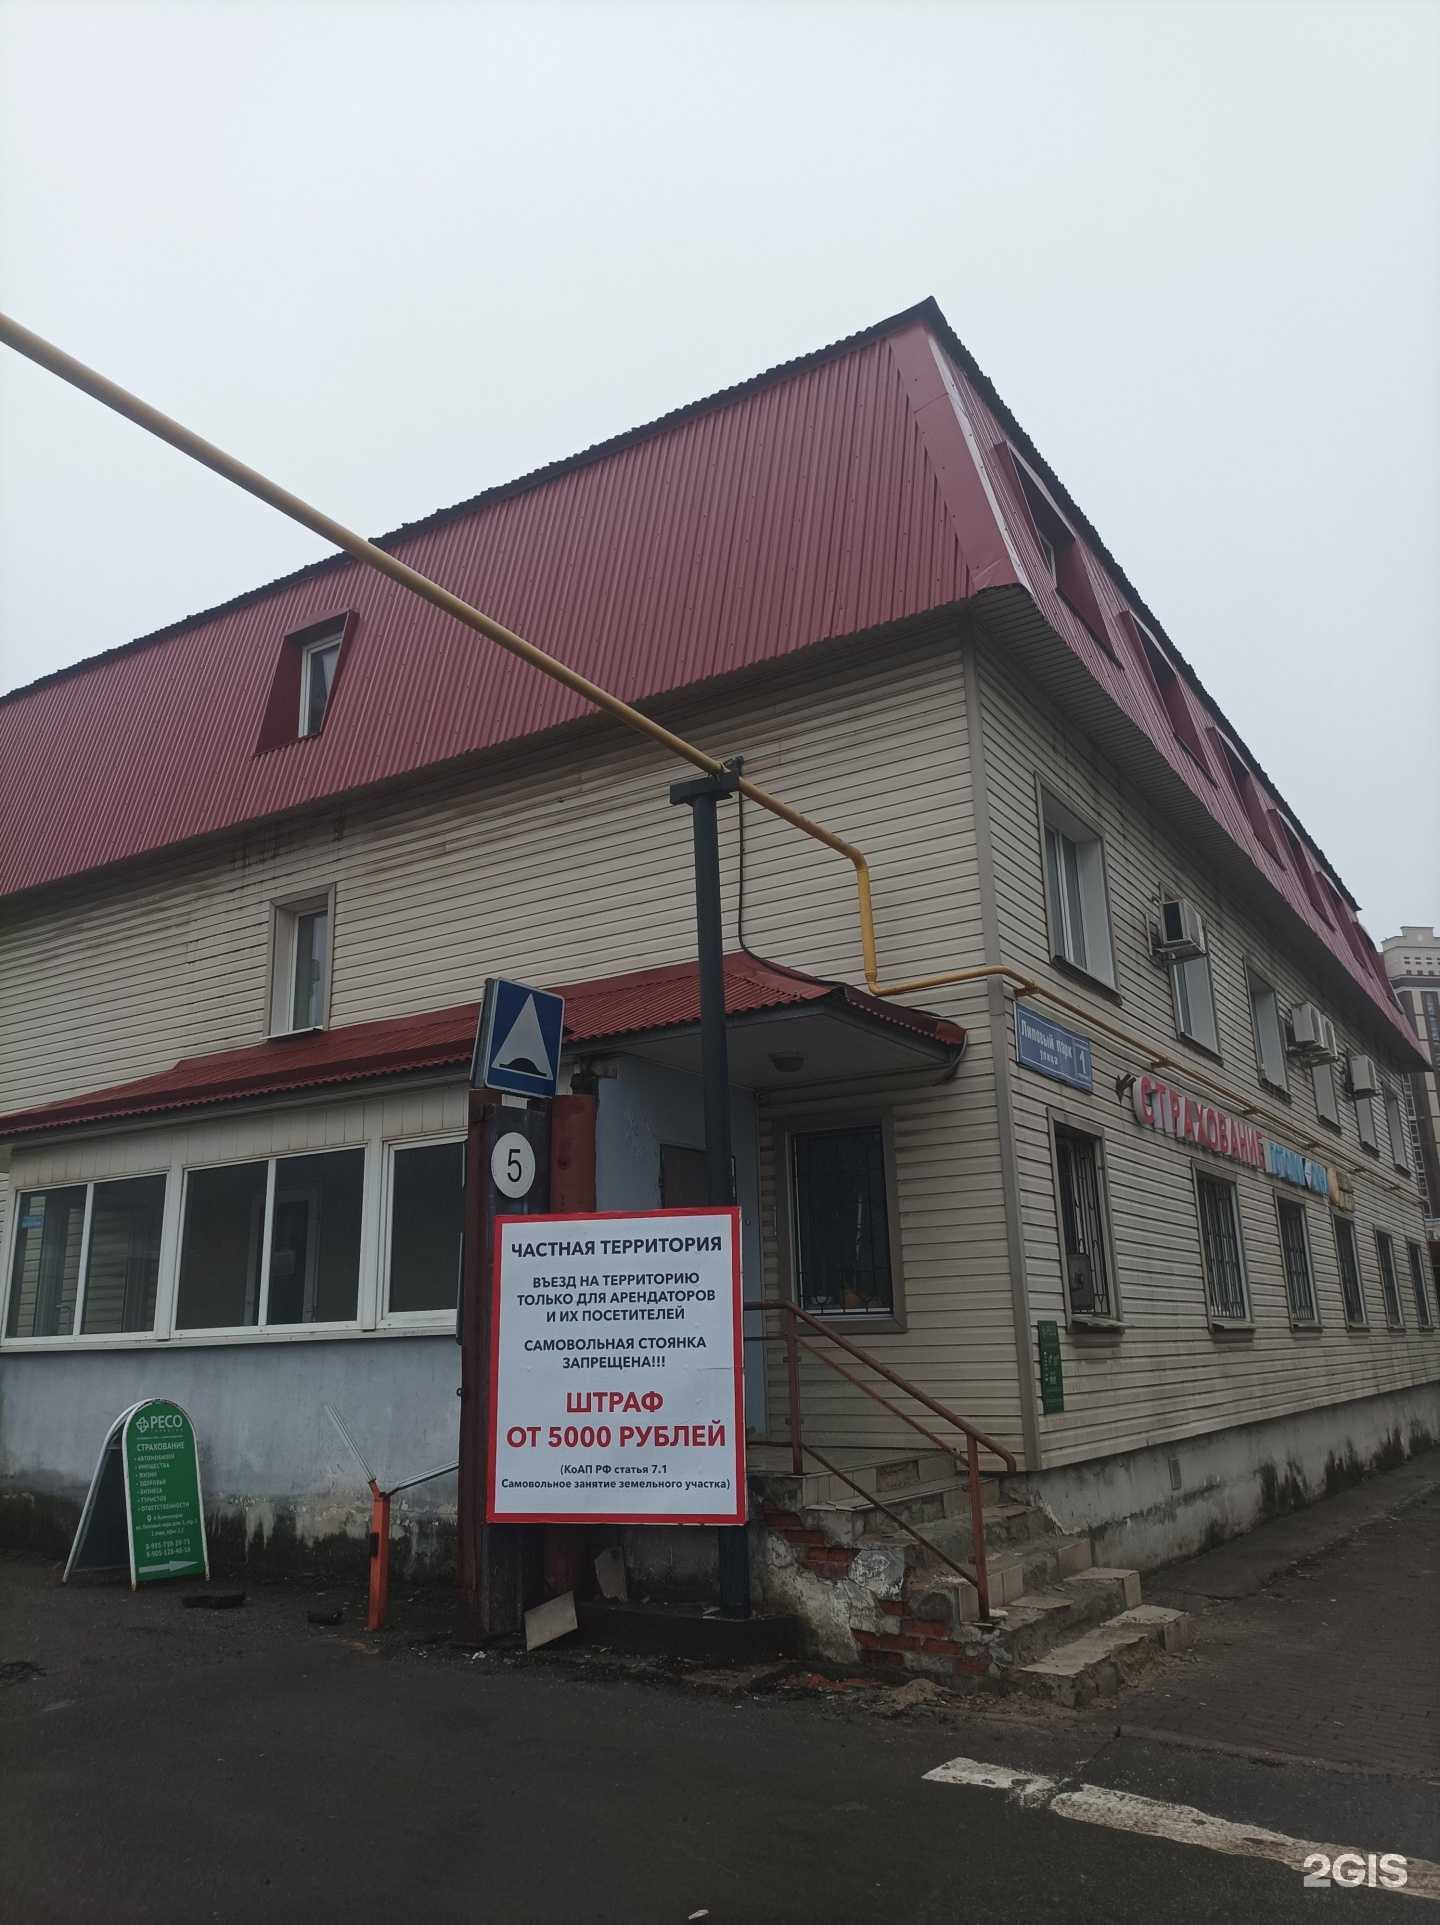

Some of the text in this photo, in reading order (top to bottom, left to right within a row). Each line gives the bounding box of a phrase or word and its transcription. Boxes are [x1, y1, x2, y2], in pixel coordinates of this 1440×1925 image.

[1080, 1050, 1087, 1074] 1
[1136, 1075, 1266, 1170] СТРАХОВАНИЕ
[506, 1148, 522, 1183] 5
[511, 1236, 722, 1257] ЧАСТНАЯ ТЕРРИТОРИЯ
[533, 1272, 700, 1289] ВЪЕЗД НА ТЕРРИТОРИЮ
[517, 1289, 716, 1306] ТОЛЬКО ДЛЯ АРЕНДАТОРОВ
[546, 1305, 685, 1323] И ИХ ПОСЕТИТЕЛЕЙ
[524, 1336, 707, 1352] САМОВОЛЬНАЯ СТОЯНКА
[562, 1356, 666, 1370] ЗАПРЕЩЕНА!!!
[566, 1390, 664, 1413] ШТРАФ
[150, 1414, 183, 1429] РЕСО
[506, 1419, 726, 1448] ОТ 5000 РУБЛЕЙ
[136, 1441, 185, 1452] СТРАХОВАНИЕ
[560, 1464, 668, 1476] (КоАП РФ статья 7.1
[501, 1478, 731, 1491] Самовольное занятие земельного участка)
